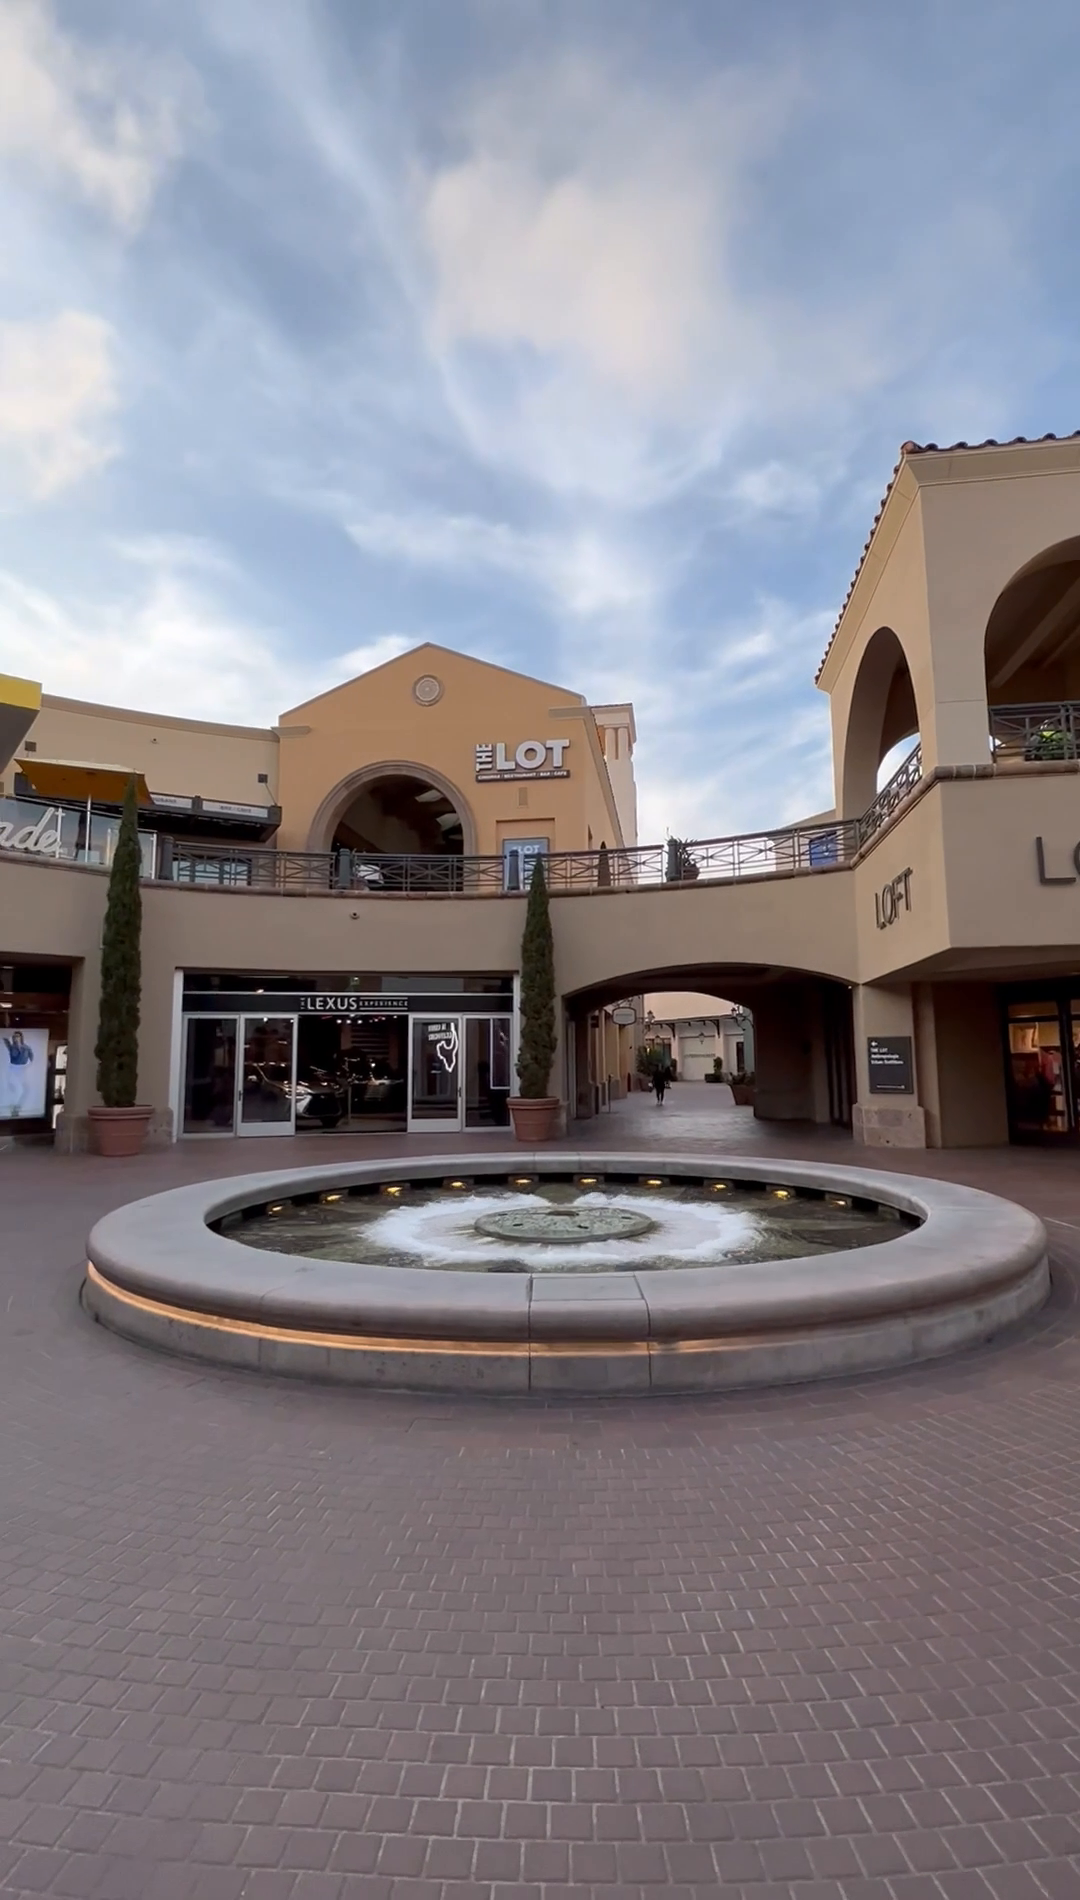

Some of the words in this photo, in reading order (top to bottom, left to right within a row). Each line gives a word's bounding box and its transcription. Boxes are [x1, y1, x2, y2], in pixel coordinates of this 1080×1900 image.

[476, 744, 492, 773] THE
[496, 739, 570, 771] LOT
[1036, 836, 1080, 887] L
[874, 867, 913, 930] LOFT
[307, 996, 358, 1010] LEXUS
